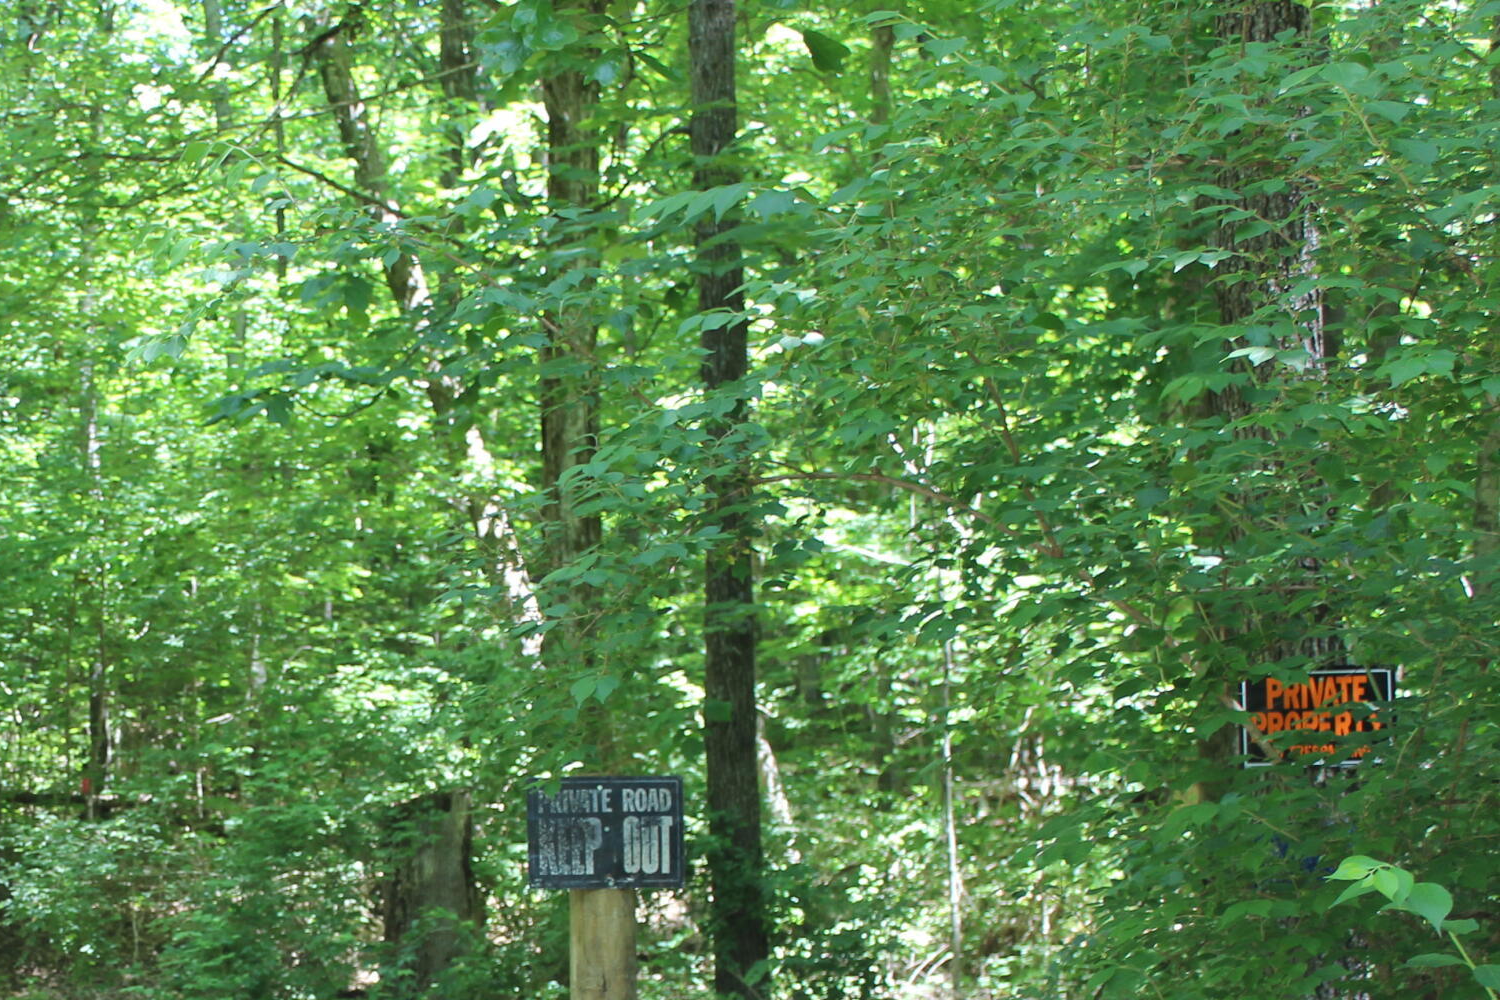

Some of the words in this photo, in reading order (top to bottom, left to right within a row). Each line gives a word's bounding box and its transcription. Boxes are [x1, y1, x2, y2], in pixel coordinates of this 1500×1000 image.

[1265, 675, 1368, 710] PRIVATE
[622, 788, 672, 812] ROAD
[622, 815, 673, 875] OUT
